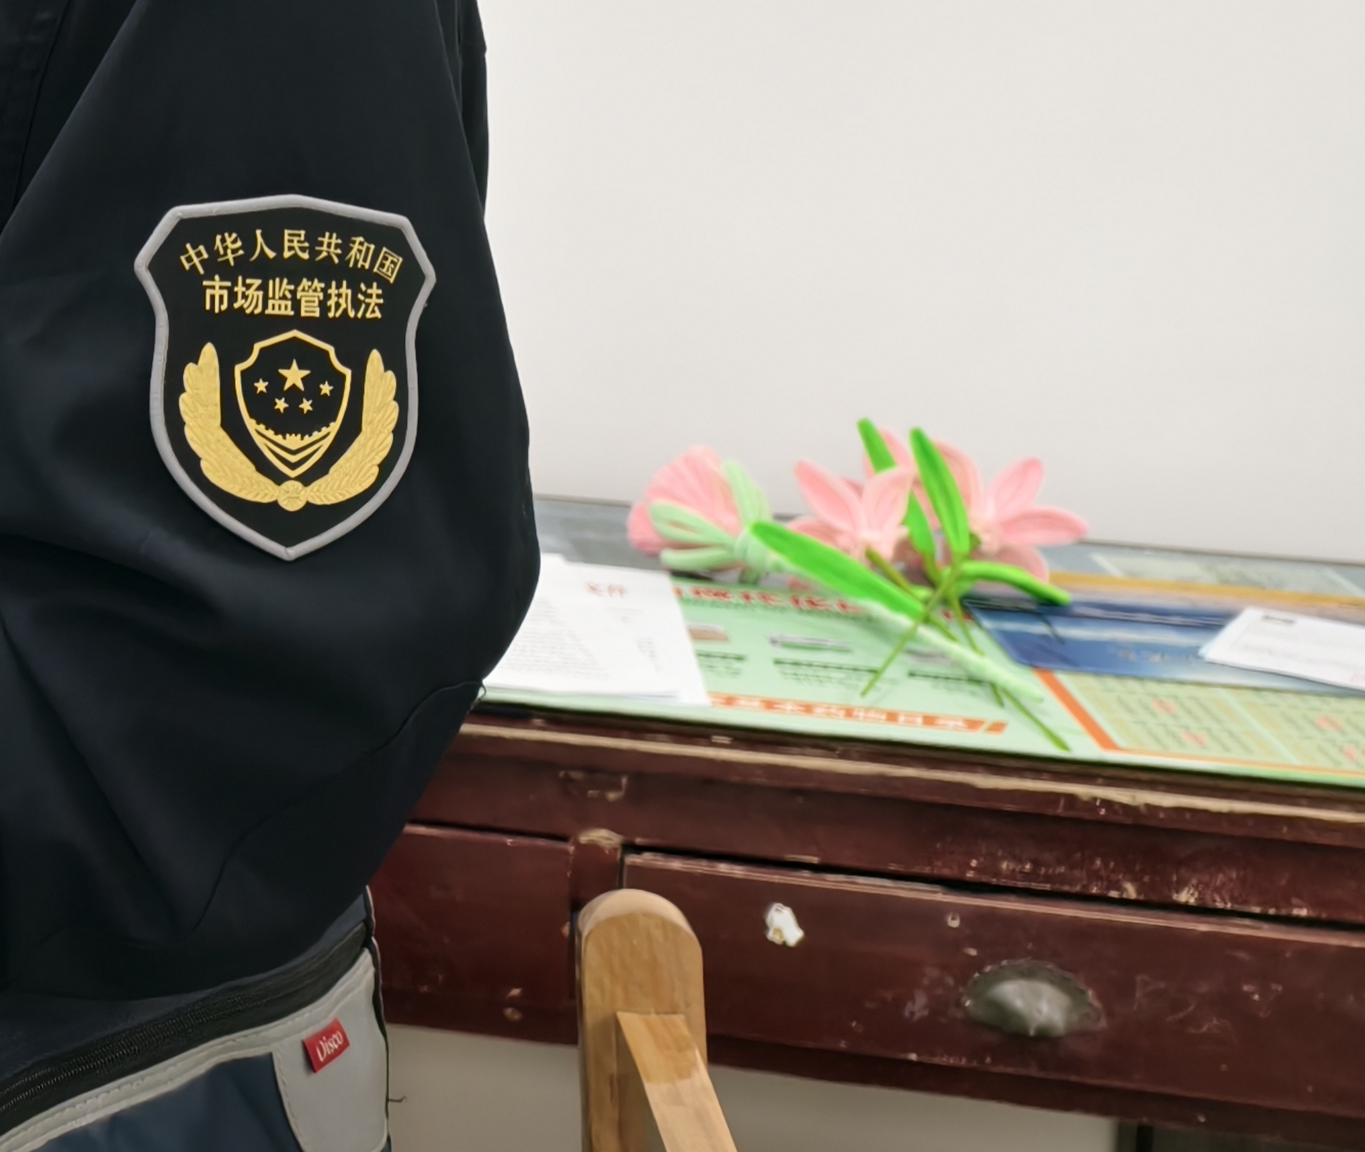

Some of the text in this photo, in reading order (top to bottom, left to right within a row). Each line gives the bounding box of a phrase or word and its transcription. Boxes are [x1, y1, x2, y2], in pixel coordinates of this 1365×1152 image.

[179, 228, 403, 284] 中华人民共和国
[203, 275, 384, 320] 市场监管执法
